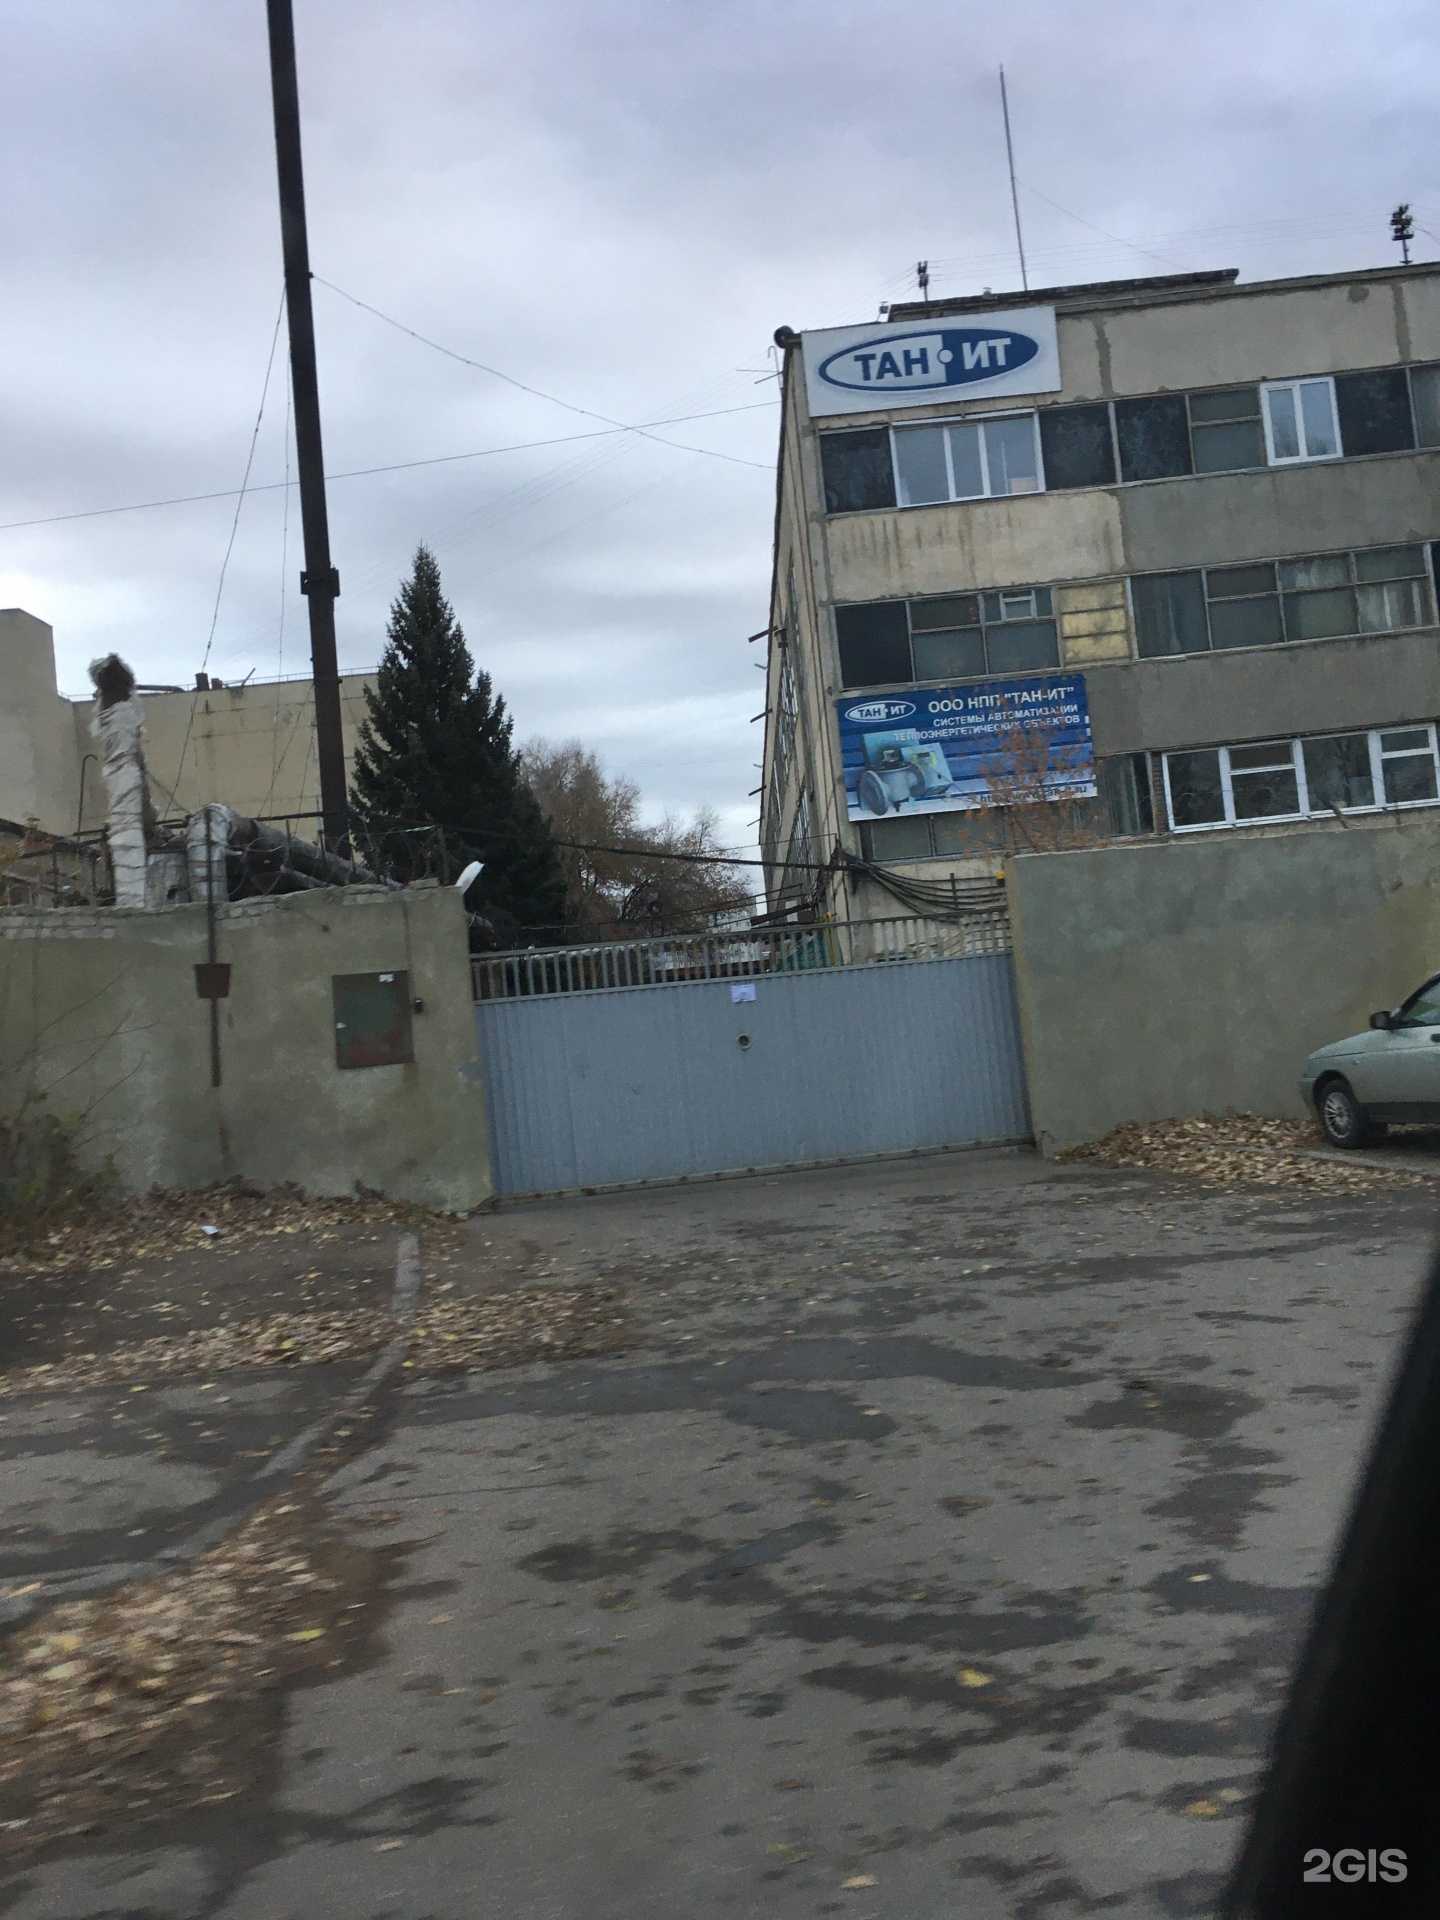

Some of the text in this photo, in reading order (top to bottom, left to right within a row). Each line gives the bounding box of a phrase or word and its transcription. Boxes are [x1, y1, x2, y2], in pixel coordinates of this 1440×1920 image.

[854, 338, 1012, 381] ТАН ИТ
[928, 686, 1075, 713] ООО НПП "ТАН-ИТ"
[933, 704, 1078, 728] СИСТЕМЫ АВТОМАТИЗАЦИИ
